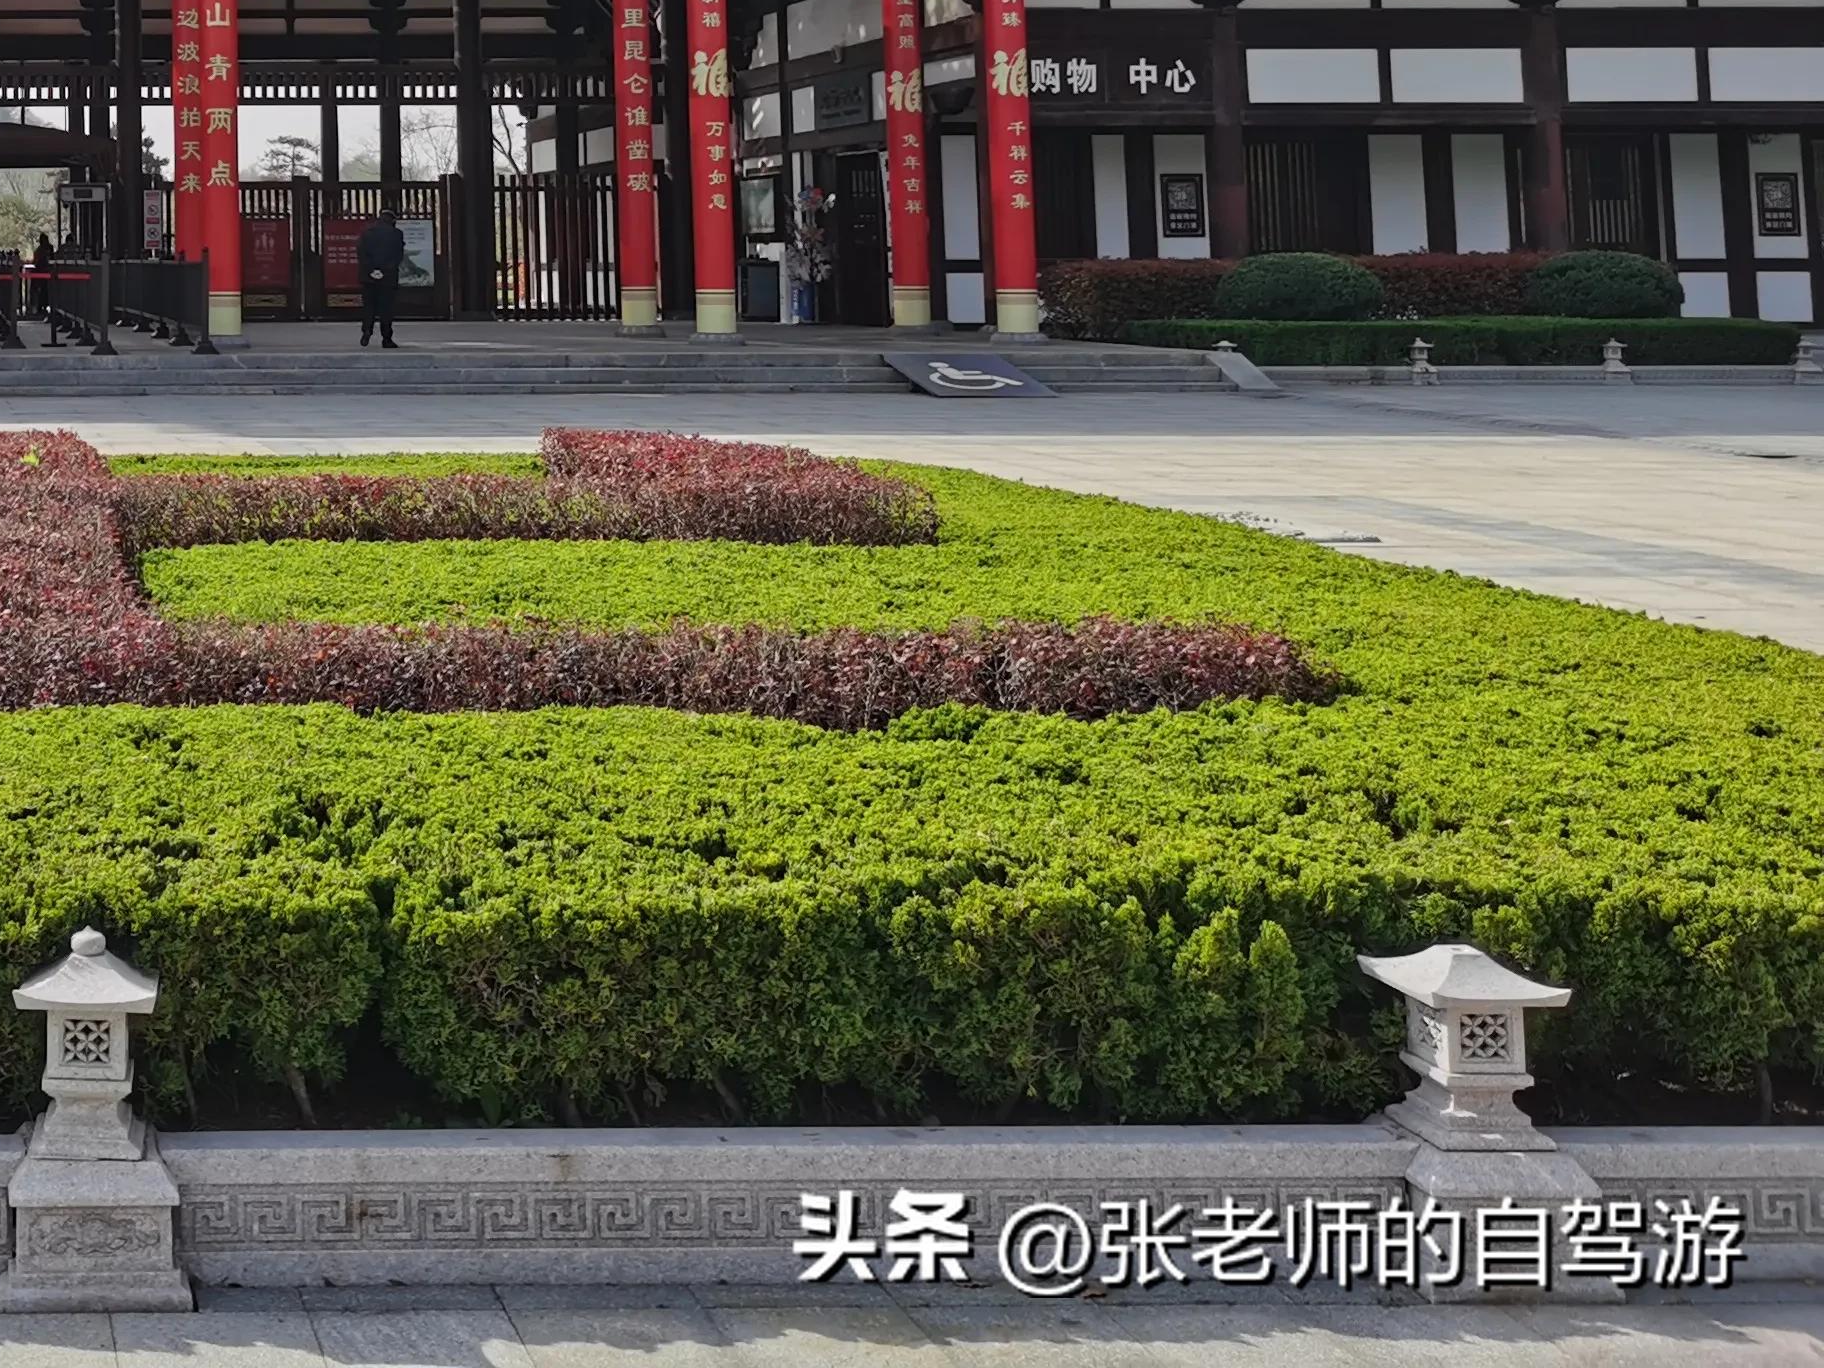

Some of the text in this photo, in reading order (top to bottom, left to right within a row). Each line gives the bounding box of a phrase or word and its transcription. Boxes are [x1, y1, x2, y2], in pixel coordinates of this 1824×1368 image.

[1030, 57, 1197, 95] 购物 中心
[705, 121, 728, 210] 万事如意
[901, 134, 923, 215] 兔年吉祥
[1007, 121, 1030, 210] 千祥云集
